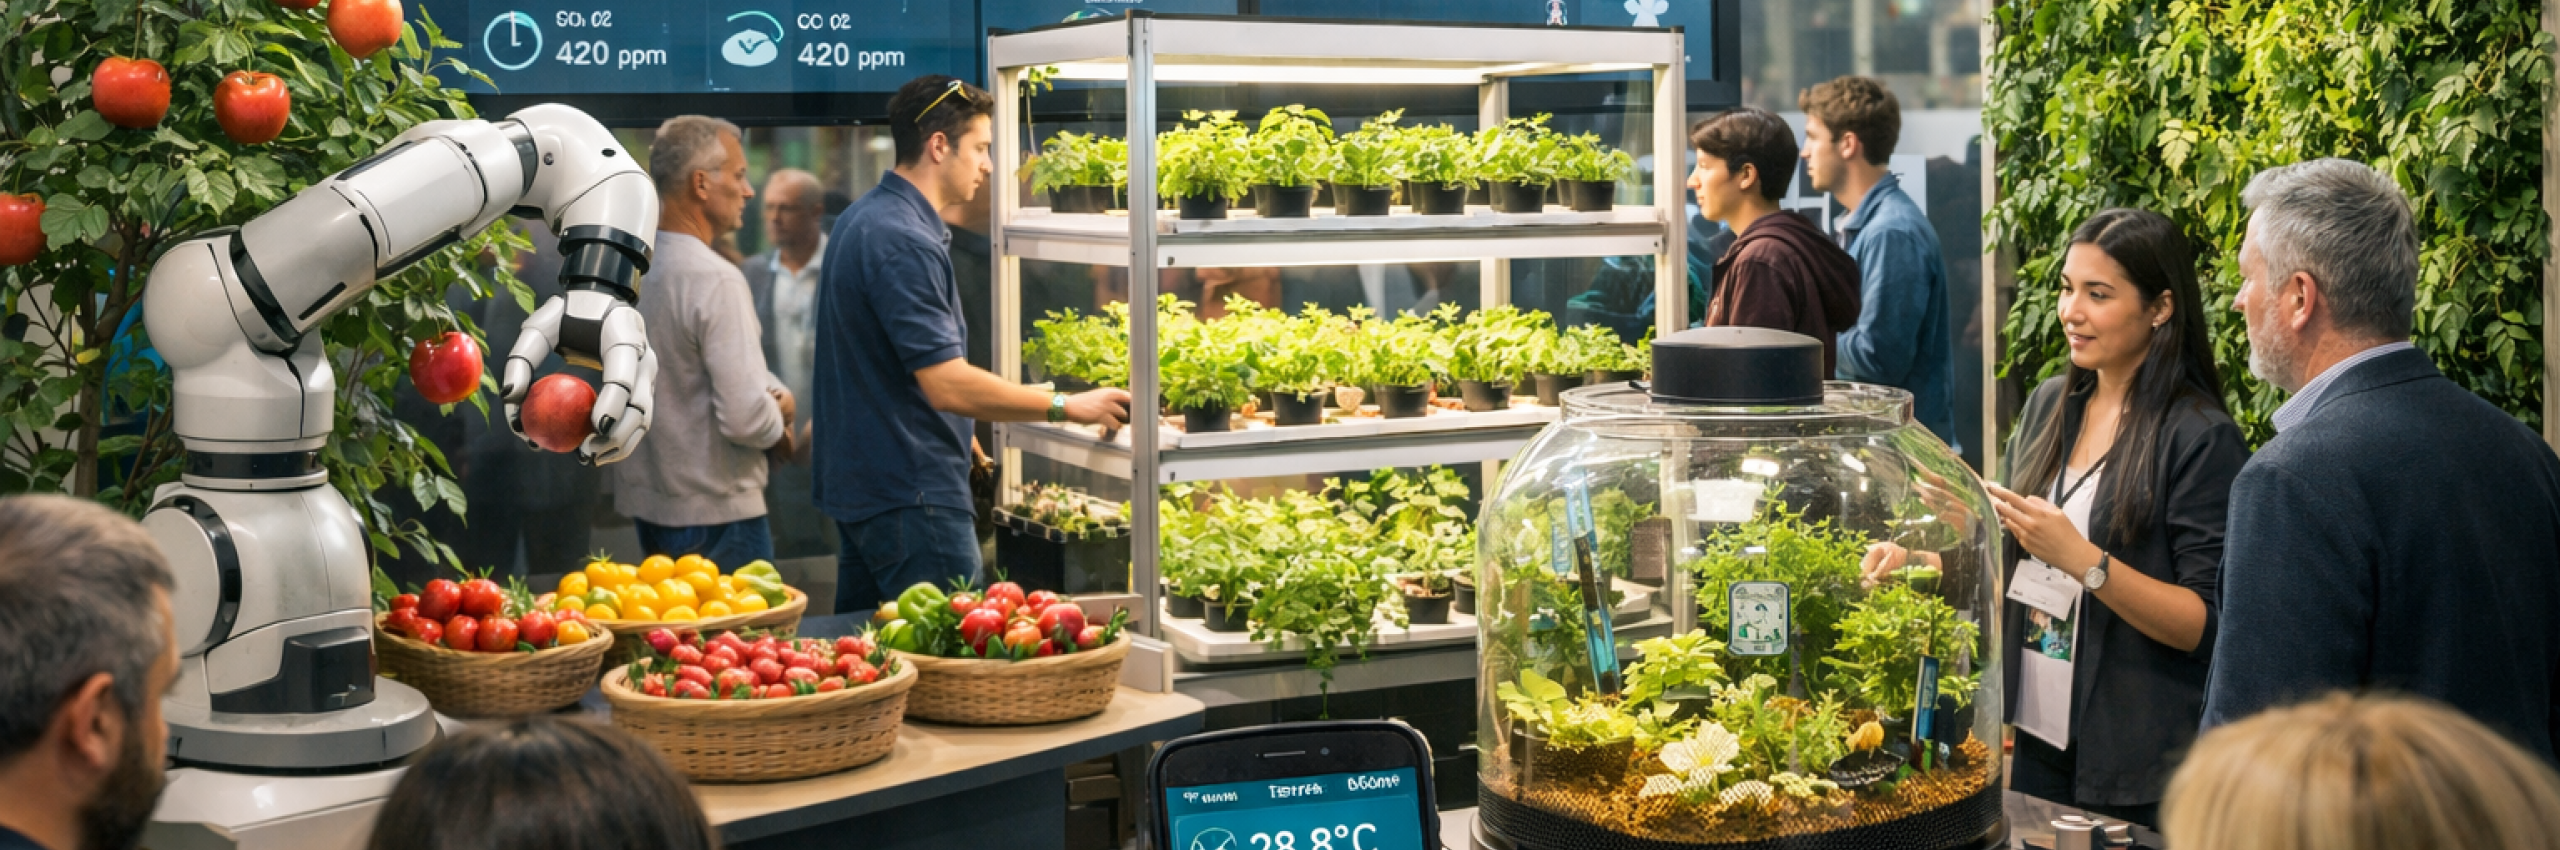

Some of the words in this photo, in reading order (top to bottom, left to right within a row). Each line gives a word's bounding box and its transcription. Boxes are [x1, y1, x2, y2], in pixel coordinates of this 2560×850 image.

[555, 40, 610, 65] 420
[618, 49, 667, 70] ppm
[798, 42, 850, 66] 420
[858, 50, 905, 71] ppm
